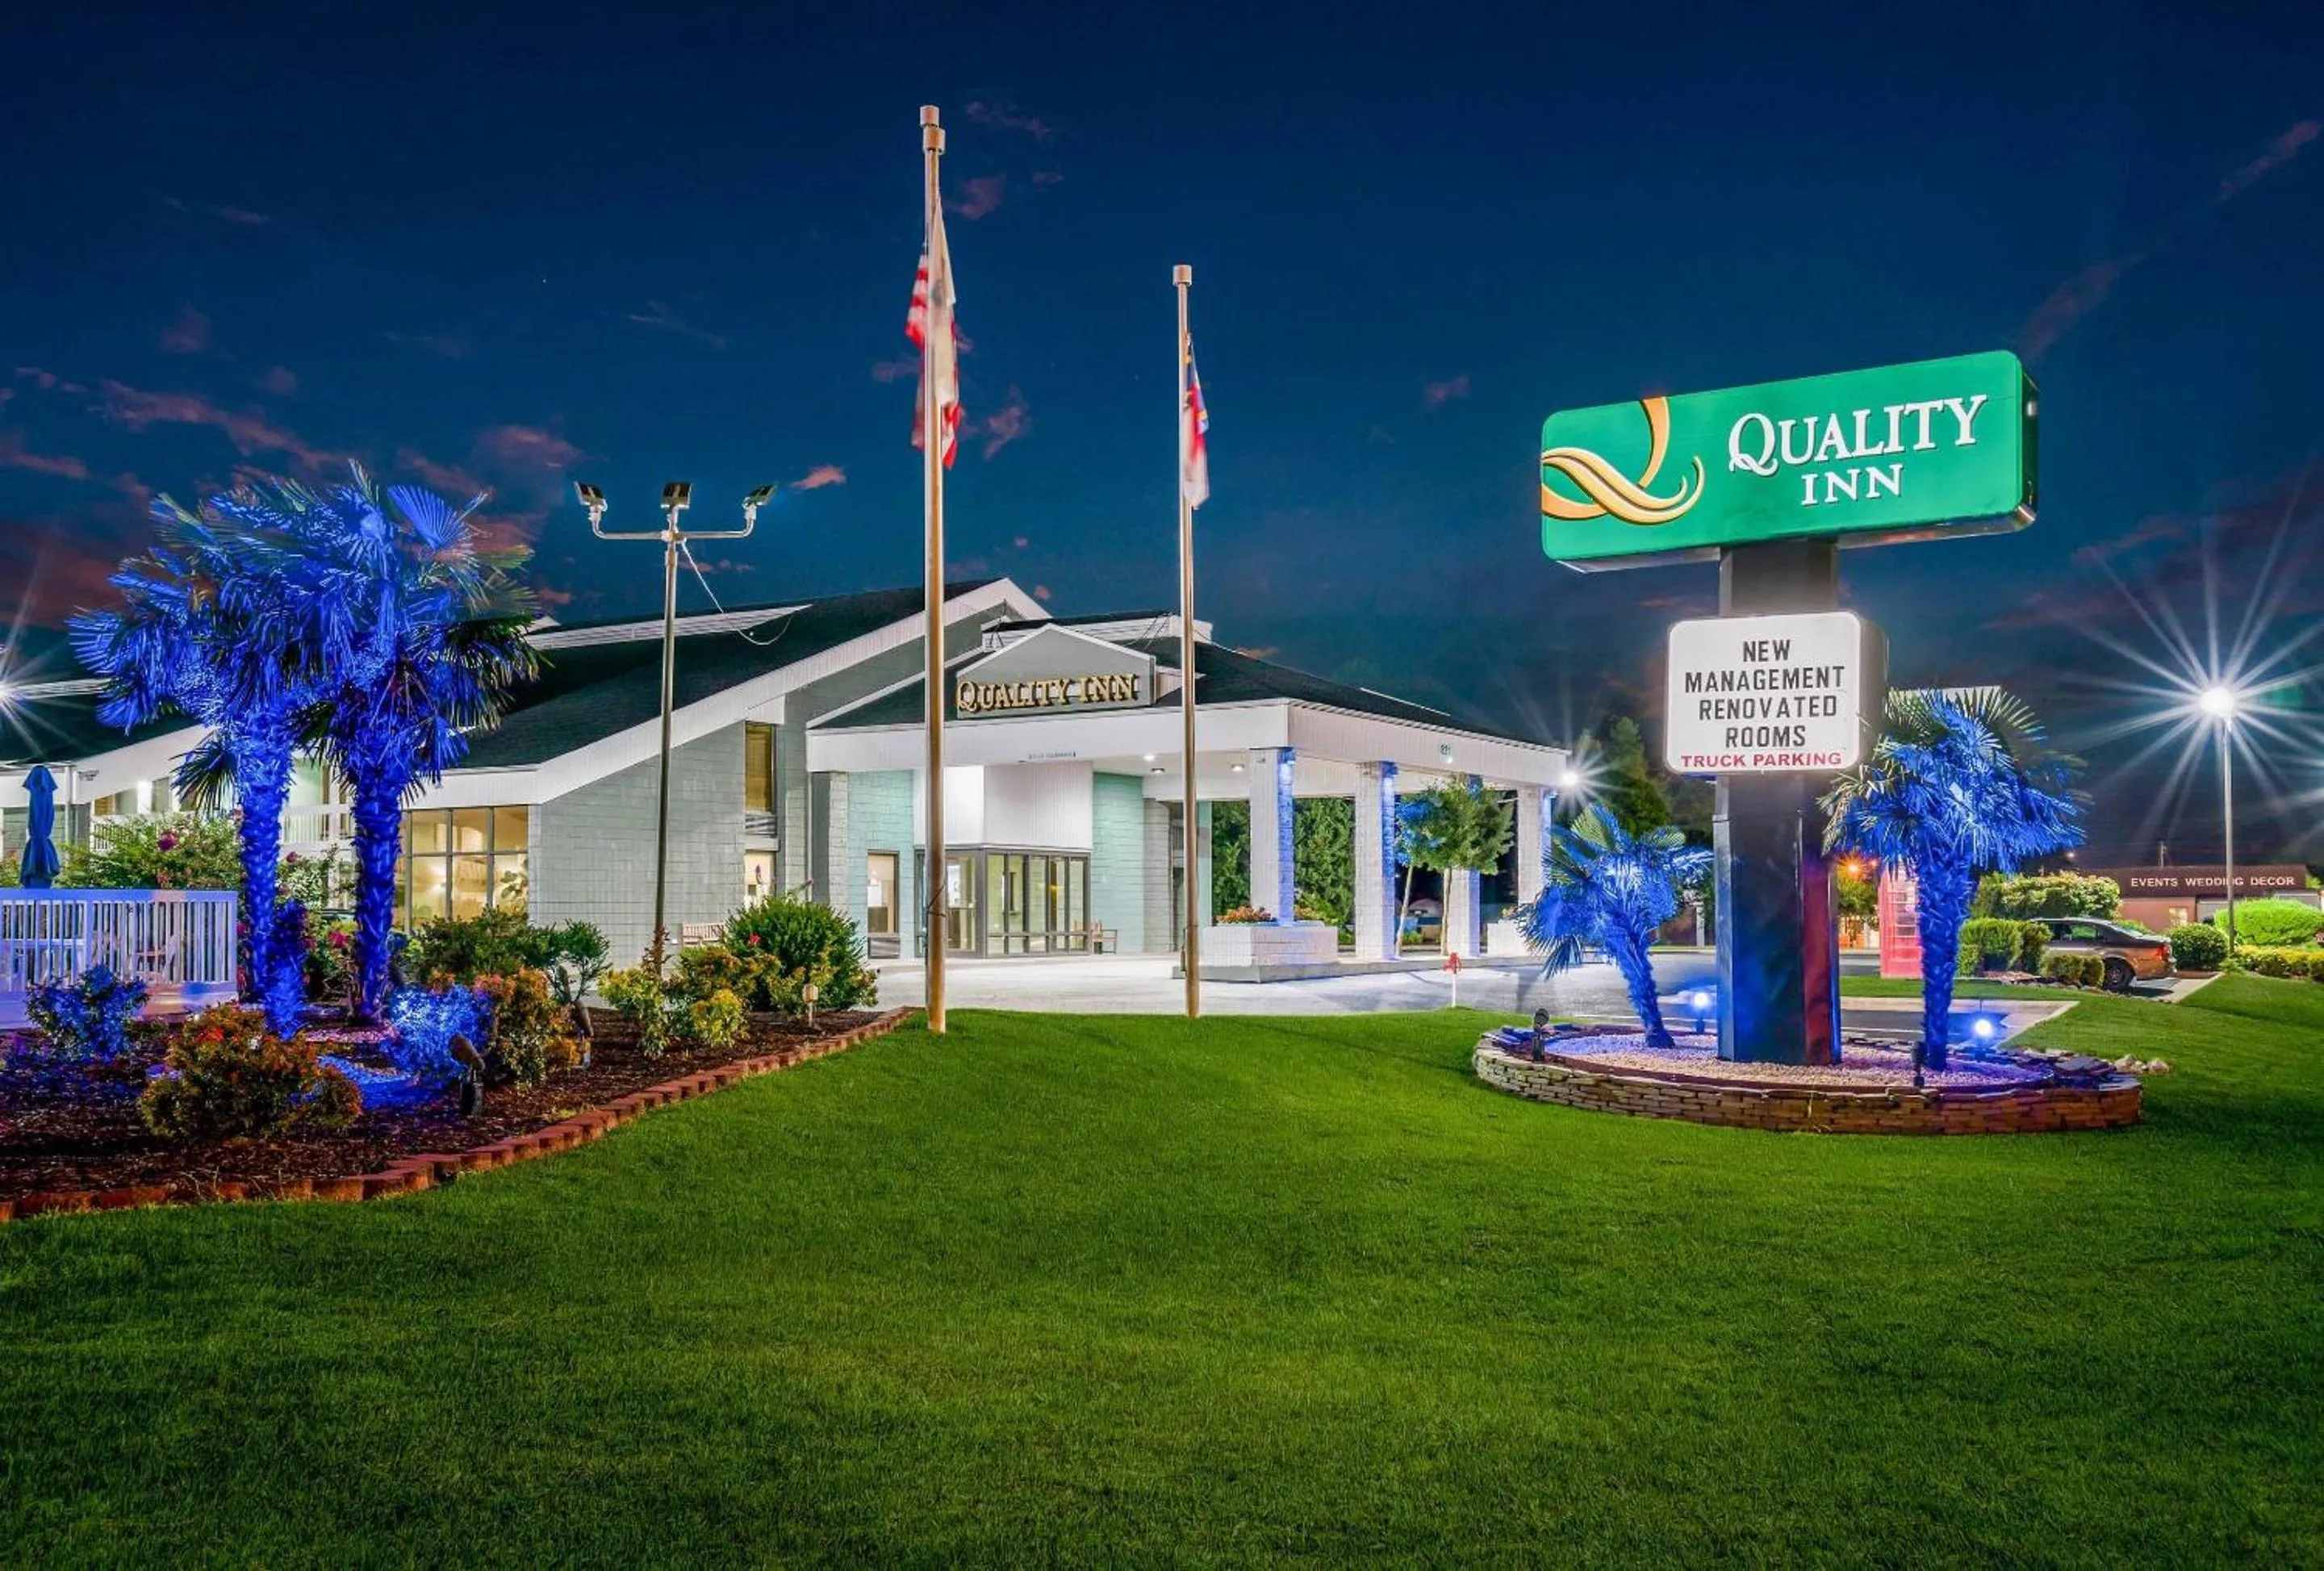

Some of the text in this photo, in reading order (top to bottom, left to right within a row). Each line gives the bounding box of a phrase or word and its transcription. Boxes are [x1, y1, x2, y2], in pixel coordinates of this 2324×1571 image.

[1728, 394, 1988, 477] QUALITY
[1801, 463, 1904, 507] INN
[1742, 639, 1791, 662] NEW
[957, 673, 1139, 712] QUALITY INN
[1684, 666, 1845, 693] MANAGEMENT
[1699, 695, 1837, 721] RENOVATED
[1725, 725, 1806, 749] ROOMS
[1681, 752, 1841, 767] TRUCK PARKING
[2131, 877, 2178, 887] EVENTS
[2251, 875, 2295, 886] DECOR
